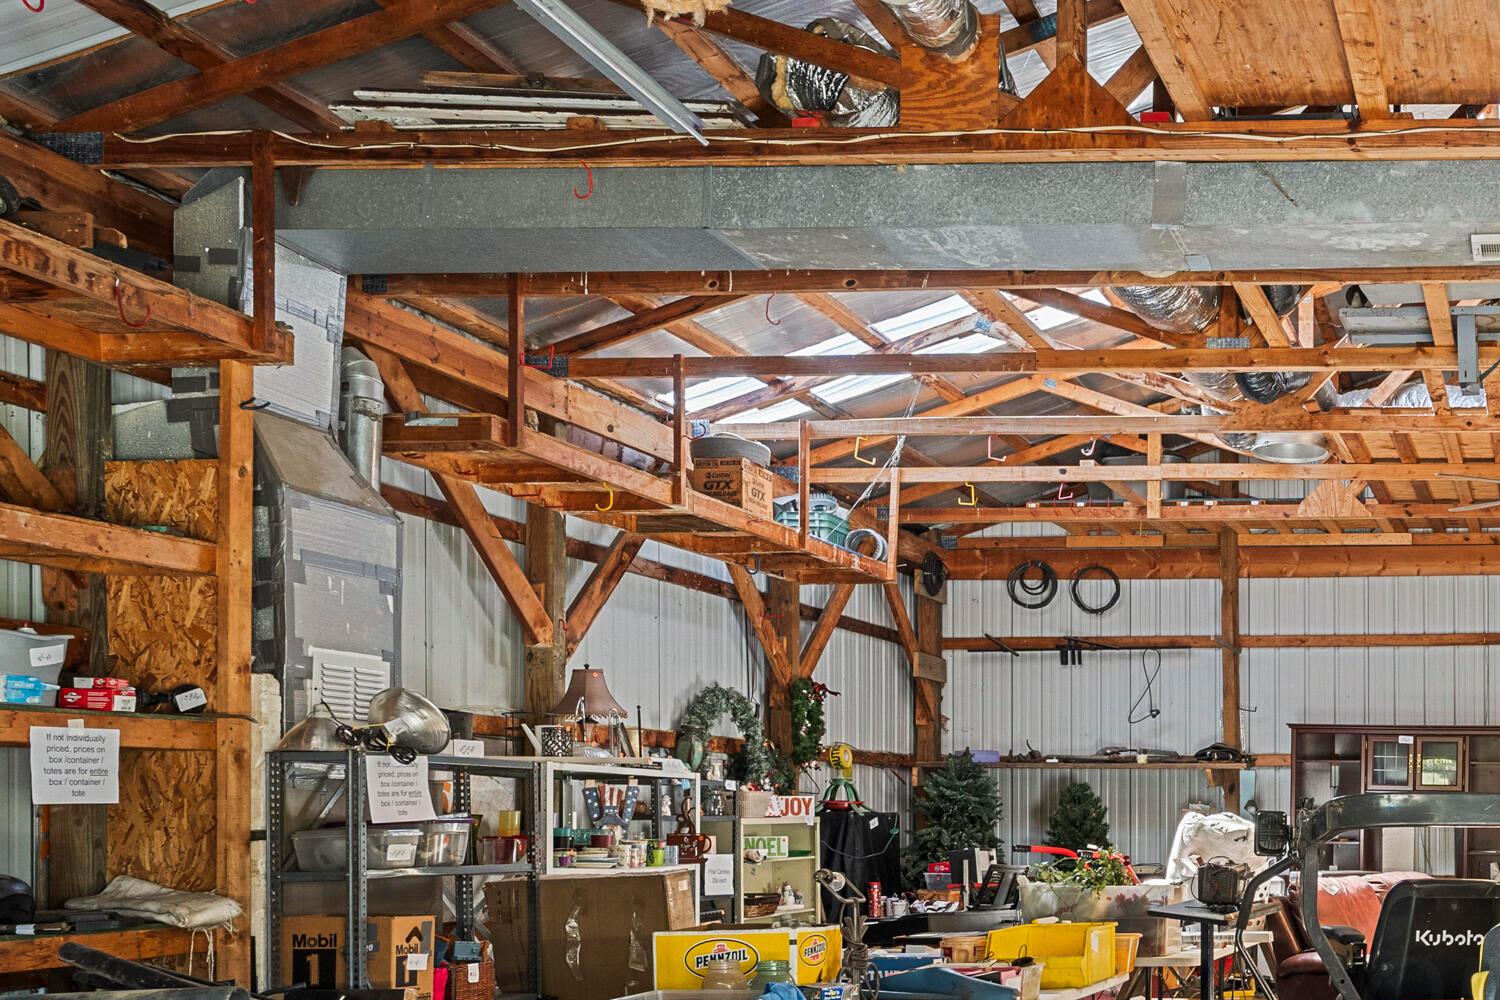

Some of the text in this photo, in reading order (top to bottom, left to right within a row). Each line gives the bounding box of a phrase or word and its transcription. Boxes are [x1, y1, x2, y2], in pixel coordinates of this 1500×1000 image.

[704, 480, 732, 490] GTX
[751, 487, 766, 502] GTX
[46, 733, 106, 745] If not individually
[46, 745, 72, 754] priced,
[73, 746, 95, 754] prices
[48, 756, 63, 764] box
[43, 767, 63, 775] totes
[78, 767, 88, 775] for
[89, 768, 109, 776] entire
[48, 778, 63, 786] box
[68, 778, 101, 786] container
[71, 789, 86, 797] tote
[781, 797, 814, 817] JOY
[744, 837, 787, 857] NOEL
[292, 933, 337, 949] Mobil
[1415, 929, 1484, 947] Kubota
[395, 943, 419, 955] Mobil
[803, 941, 827, 958] PENNZOIL
[695, 948, 749, 969] PENNZOIL
